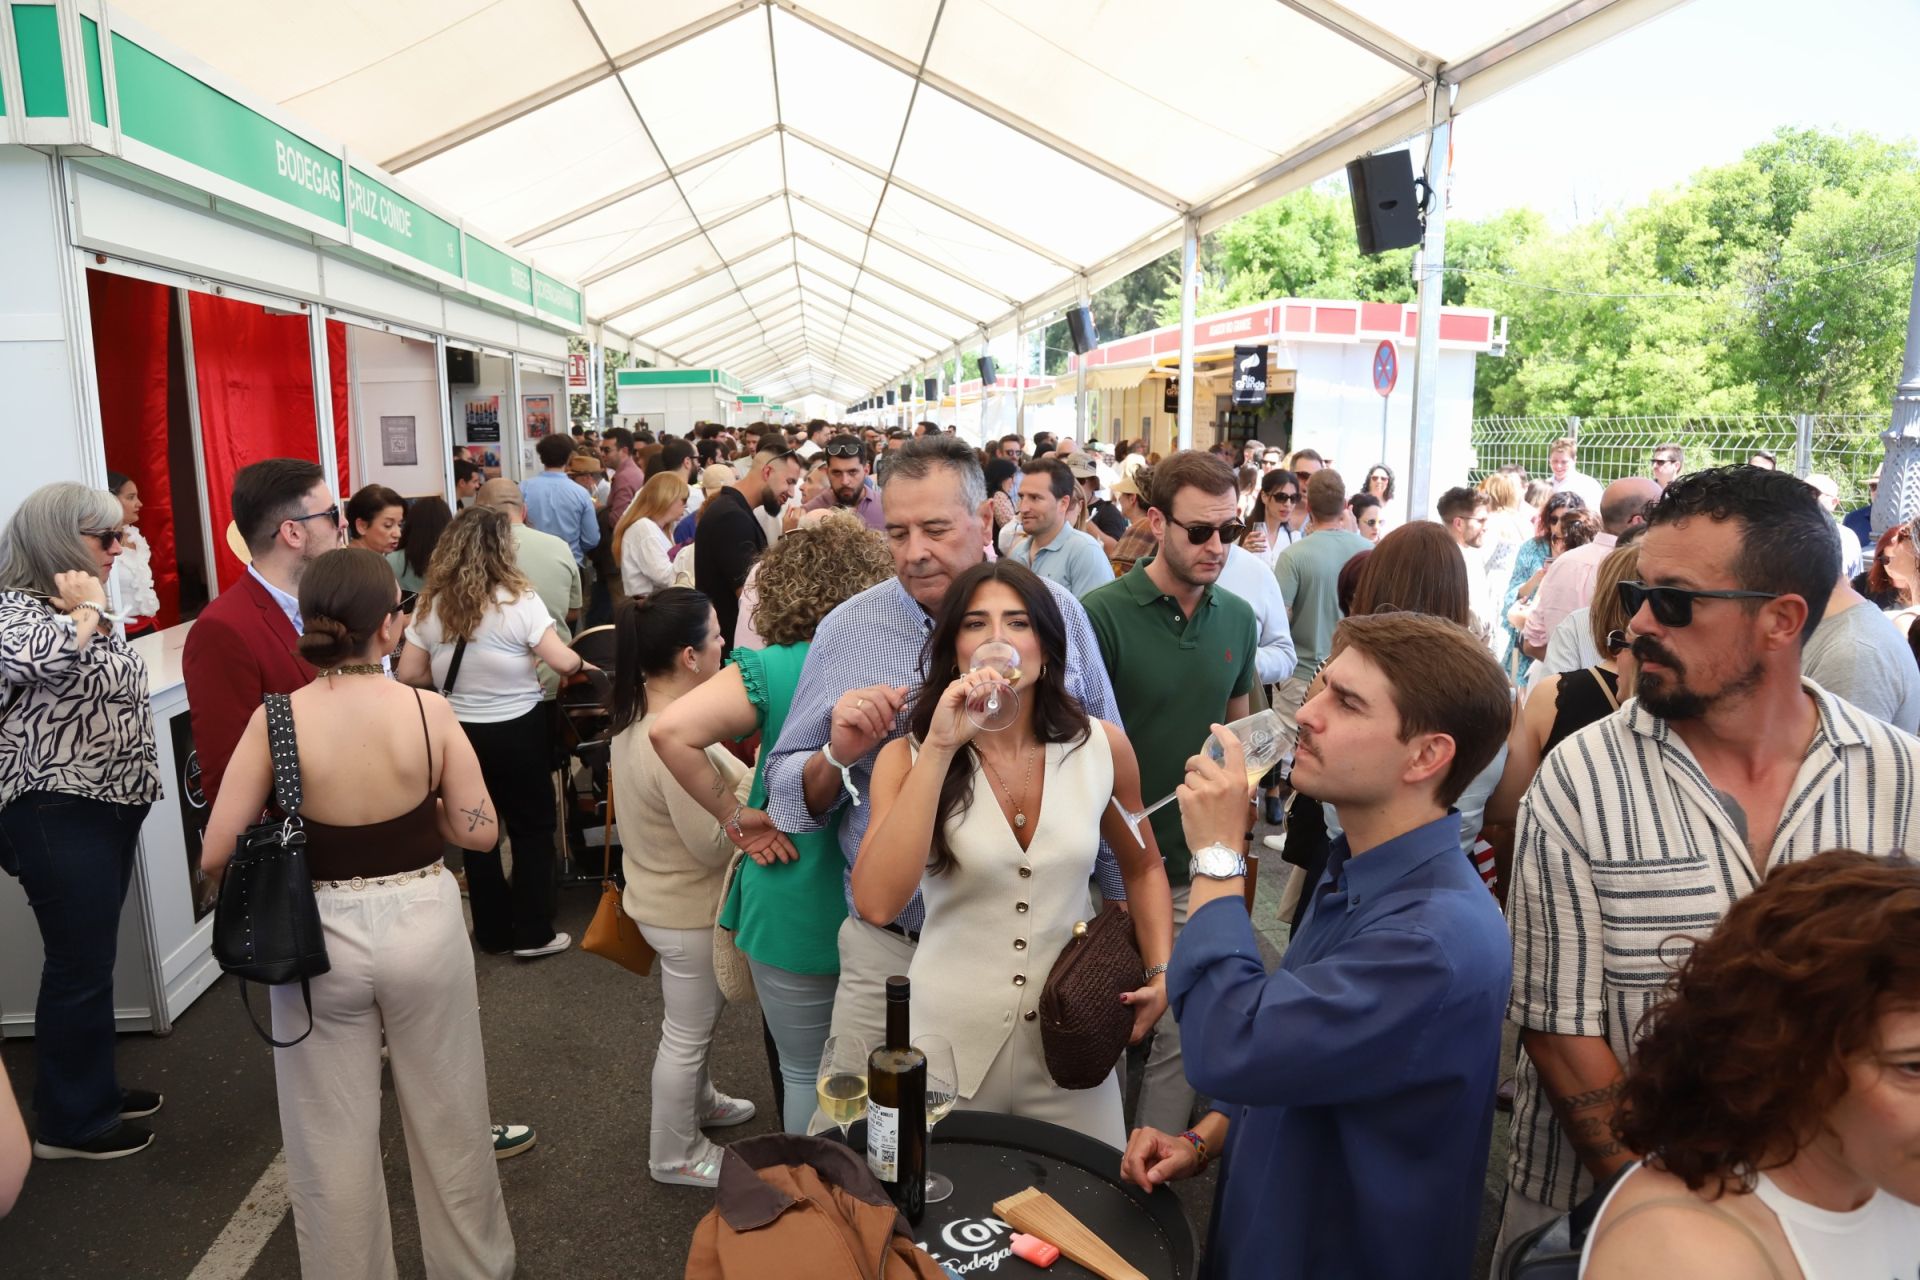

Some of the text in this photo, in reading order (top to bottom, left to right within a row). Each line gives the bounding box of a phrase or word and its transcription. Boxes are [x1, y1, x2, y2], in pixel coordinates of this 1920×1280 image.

[275, 139, 341, 203] BODEGAS
[348, 178, 412, 238] CRUZ CONDE
[942, 1217, 1013, 1252] CON
[939, 1247, 1013, 1274] Bodega
